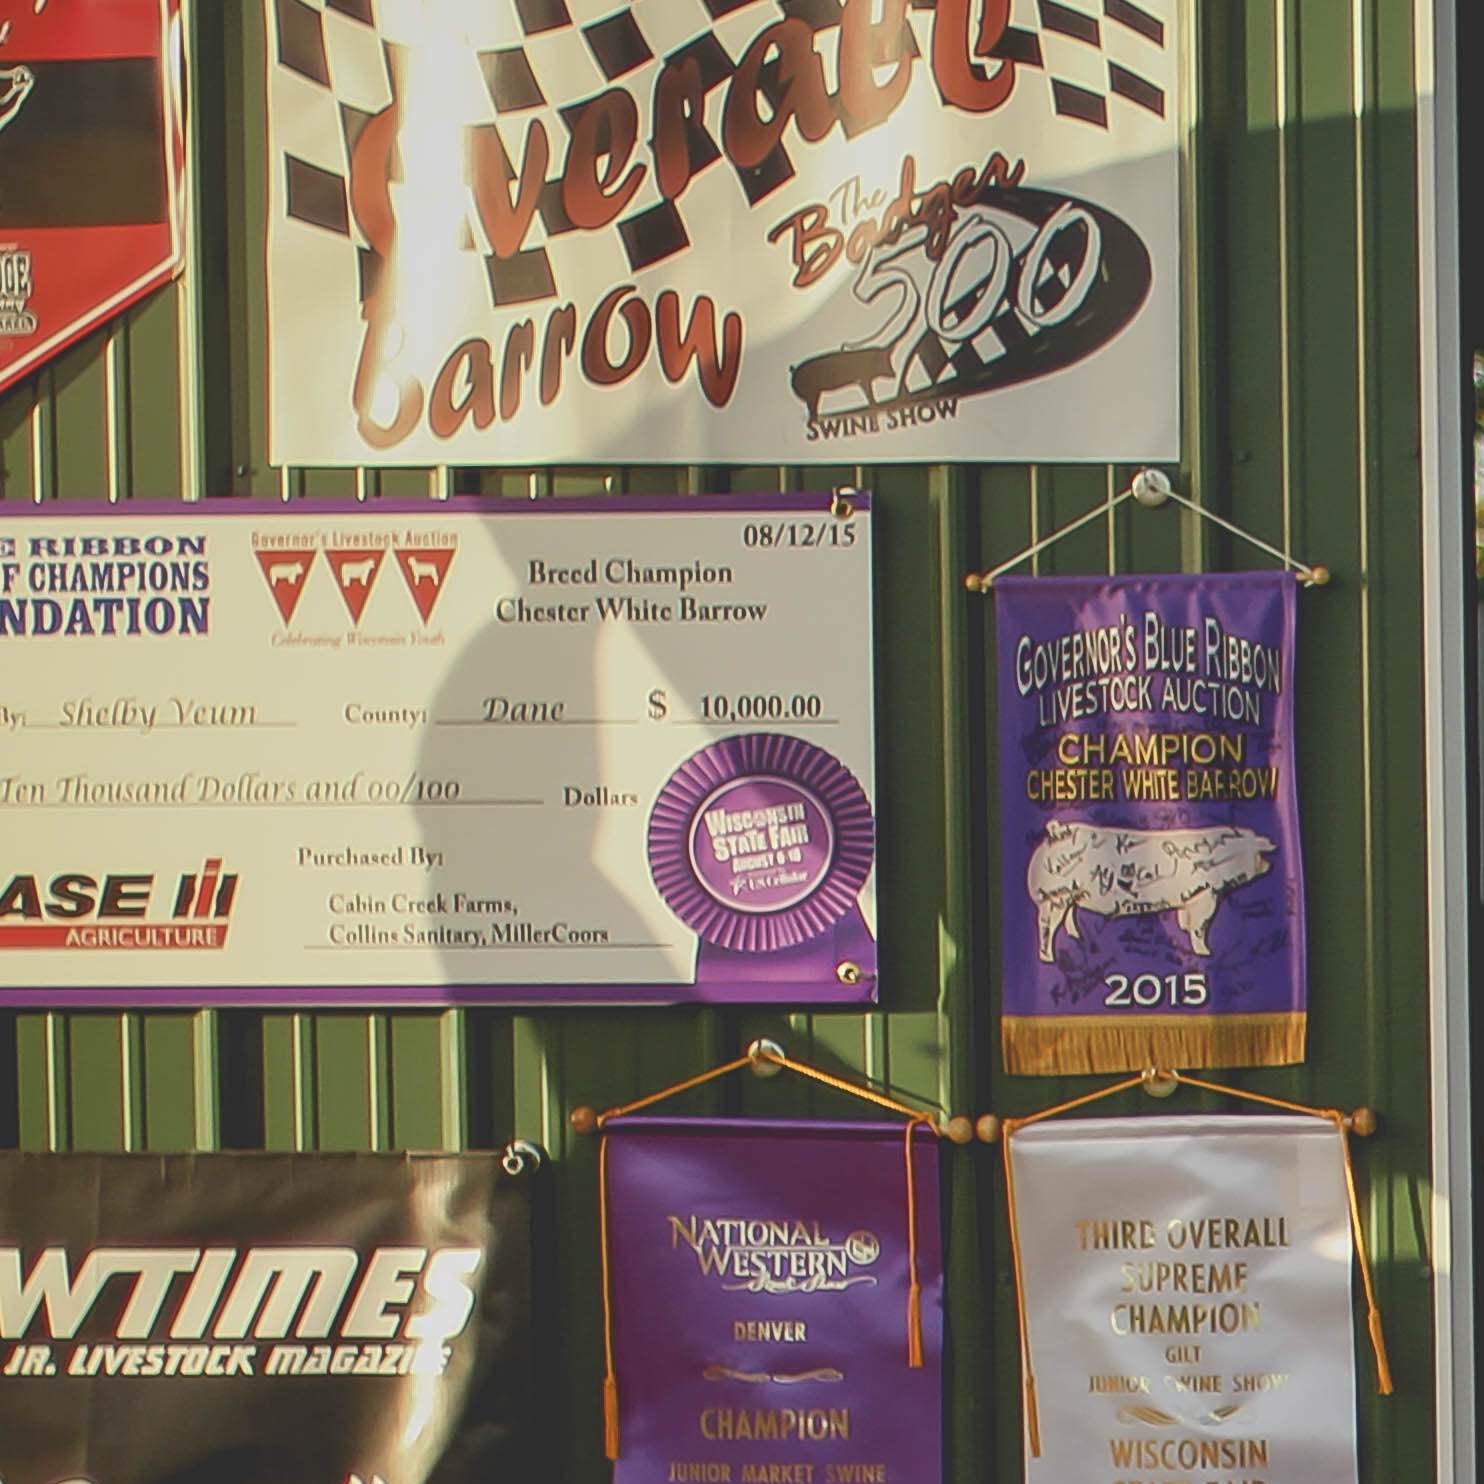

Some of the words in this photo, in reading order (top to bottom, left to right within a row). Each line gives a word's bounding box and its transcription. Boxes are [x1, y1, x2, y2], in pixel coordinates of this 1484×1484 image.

[833, 176, 888, 224] The
[767, 152, 1025, 288] Badger
[841, 202, 1101, 351] 500
[887, 400, 958, 430] SHOW
[29, 536, 207, 556] RIBBON
[743, 523, 855, 548] 08/12/15
[29, 561, 209, 592] CHAMPIONS
[529, 559, 597, 584] Breed
[605, 559, 732, 591] Champion
[496, 598, 589, 622] Chester
[596, 598, 671, 621] White
[681, 598, 767, 622] Barrow
[1016, 614, 1137, 696] GOVERNOR'S
[1144, 612, 1196, 672] BLUE
[1205, 617, 1280, 694] RIBBON
[59, 698, 156, 734] Shelby
[345, 703, 427, 729] County:
[482, 697, 565, 722] Dane
[700, 696, 821, 723] 10,000.00
[1039, 675, 1152, 727] LIVESTOCK
[1162, 676, 1260, 726] AUCTION
[1057, 734, 1244, 766] CHAMPION
[57, 773, 194, 802] Thousand
[197, 774, 297, 802] Dollars
[305, 772, 363, 802] and
[368, 771, 460, 803] 00/100
[564, 787, 638, 807] Dollars
[1027, 769, 1114, 800] CHESTER
[1122, 769, 1180, 800] WHITE
[299, 847, 401, 867] Purchased
[411, 847, 443, 872] By:
[329, 894, 385, 914] Cabin
[392, 894, 447, 913] Creek
[454, 894, 518, 916] Farms,
[65, 927, 217, 947] AGRICULTURE
[329, 924, 398, 944] Collins
[403, 924, 487, 946] Sanitary,
[492, 923, 608, 944] MillerCoors
[1105, 974, 1208, 1006] 2015
[668, 1215, 830, 1252] NATIONAL
[1168, 1217, 1290, 1250] OVERALL
[697, 1249, 847, 1276] WESTERN
[1121, 1262, 1248, 1294] SUPREME
[734, 1321, 806, 1342] DENVER
[1111, 1303, 1262, 1335] CHAMPION
[5, 1344, 55, 1376] JR.
[69, 1344, 256, 1376] LIVESTOCK
[701, 1408, 849, 1440] CHAMPION
[1110, 1440, 1268, 1470] WISCONSIN
[669, 1463, 731, 1483] JUNIOR
[742, 1464, 814, 1484] MARKET
[825, 1464, 886, 1484] SWINE
